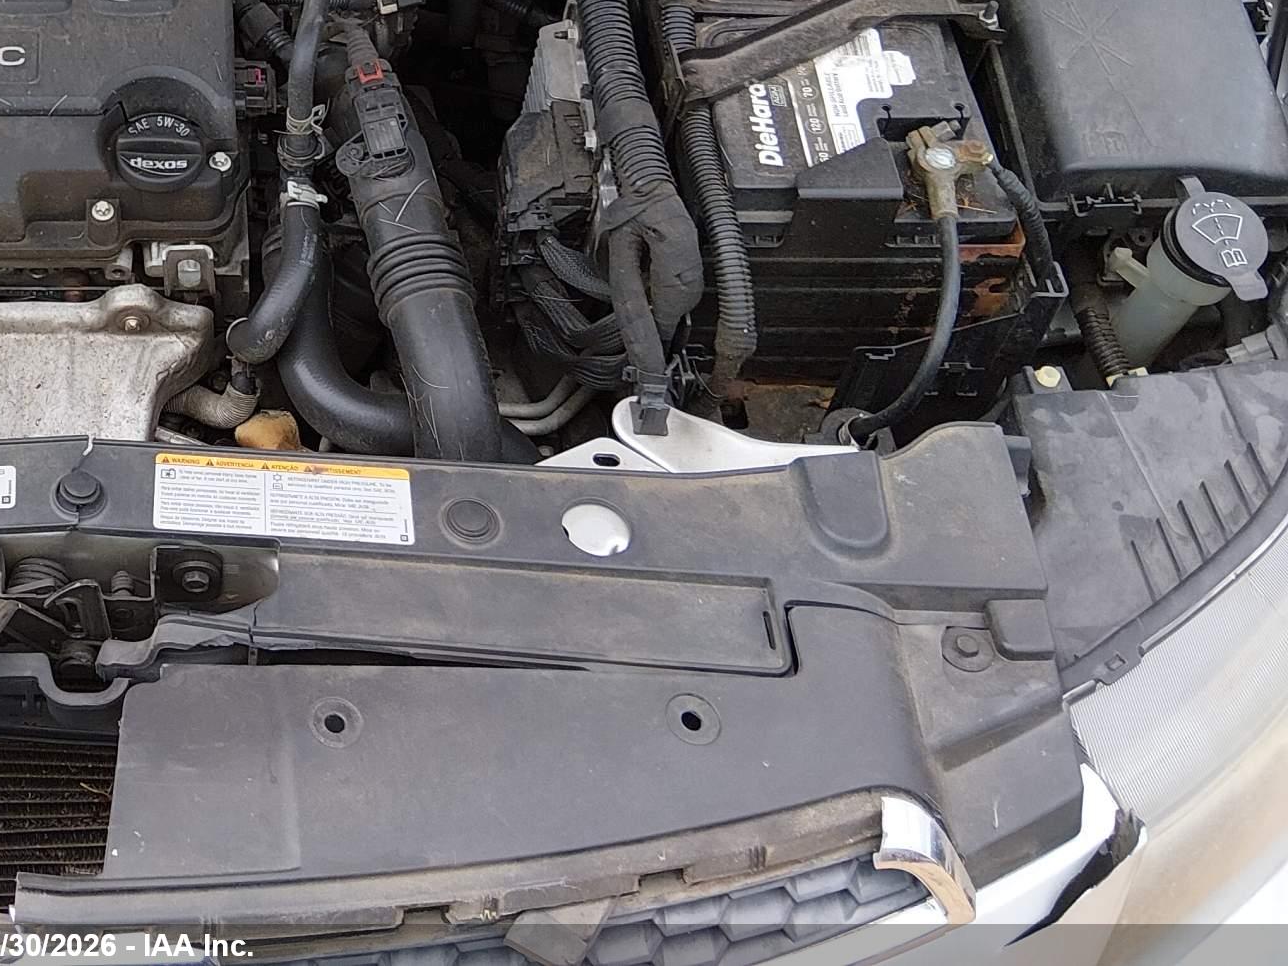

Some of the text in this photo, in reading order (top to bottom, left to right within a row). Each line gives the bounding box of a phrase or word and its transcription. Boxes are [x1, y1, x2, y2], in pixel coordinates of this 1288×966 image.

[128, 117, 191, 137] SAE 5W-30
[130, 158, 188, 170] dexos
